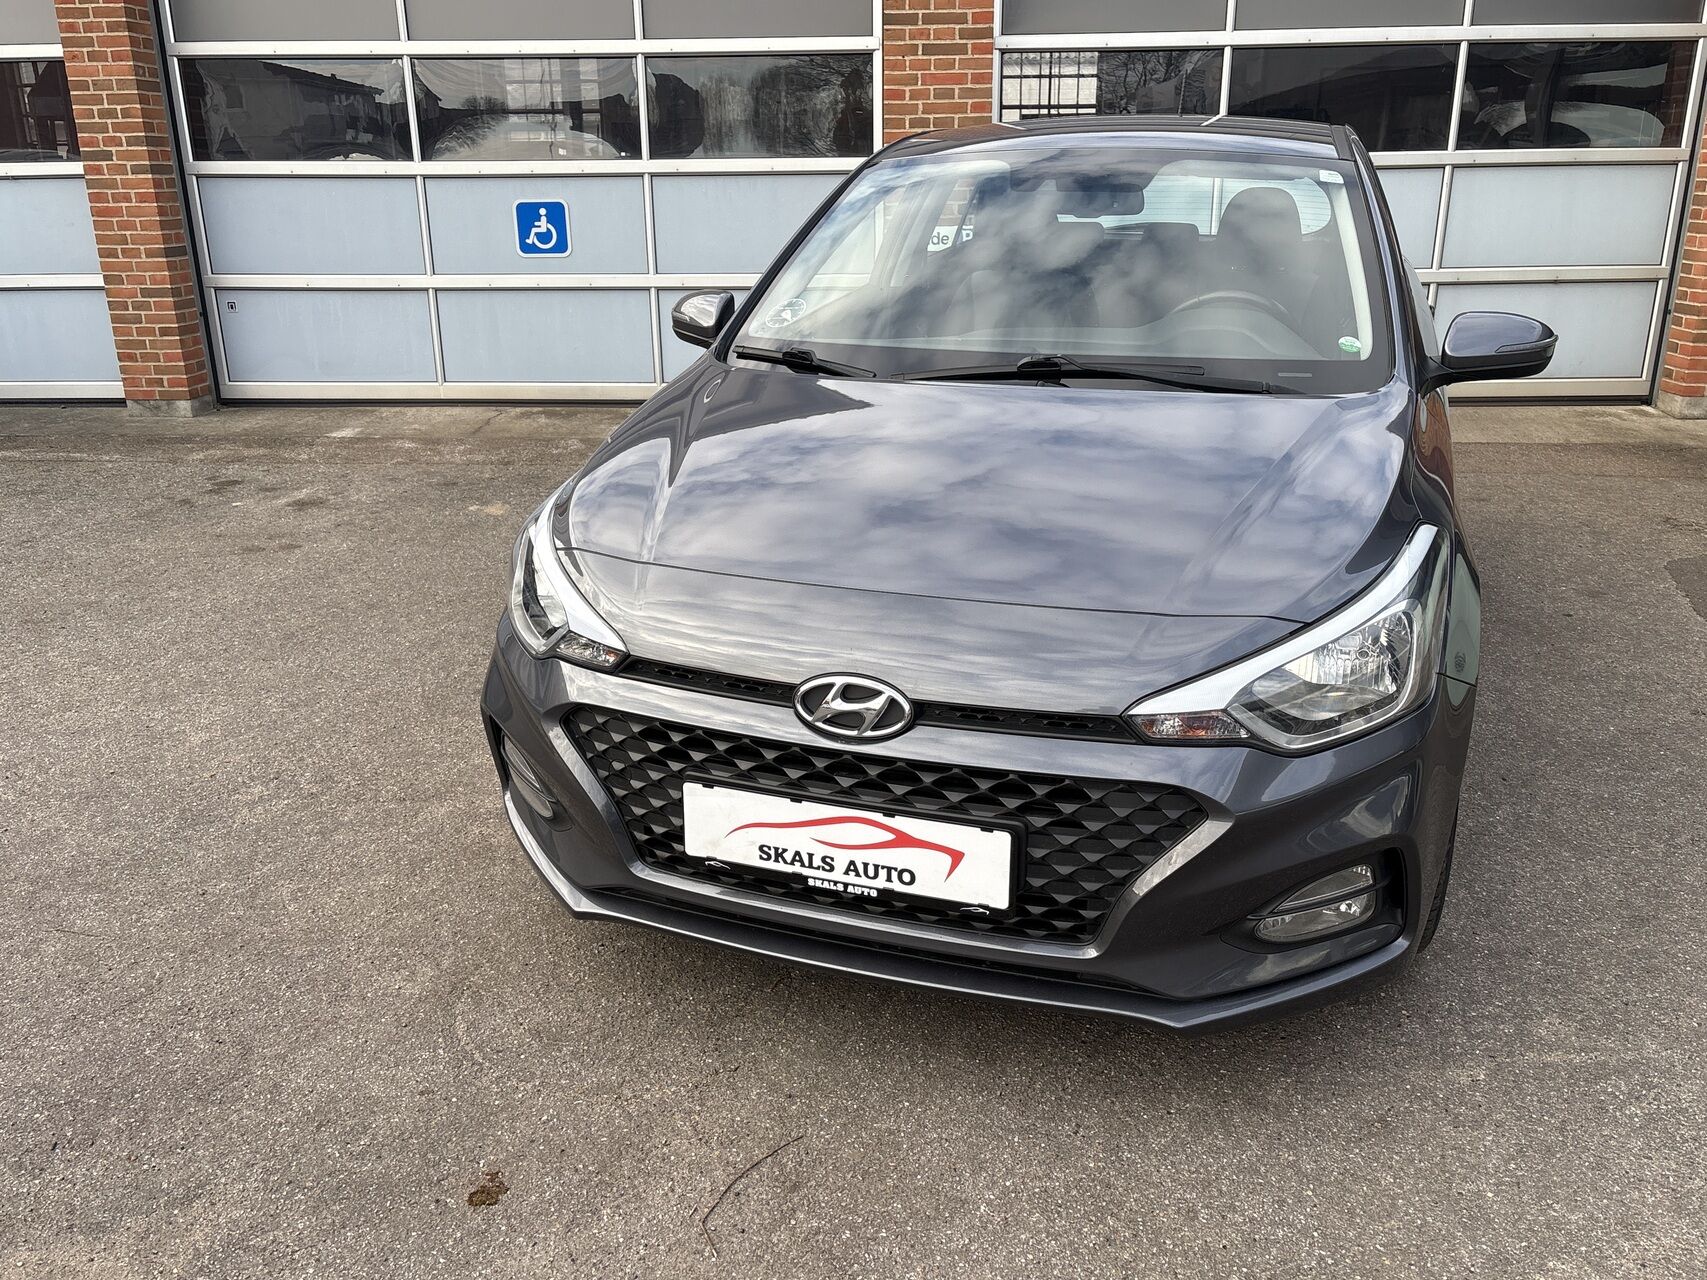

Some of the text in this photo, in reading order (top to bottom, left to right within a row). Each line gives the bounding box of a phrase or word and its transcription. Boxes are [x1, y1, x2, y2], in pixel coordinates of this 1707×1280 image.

[758, 844, 916, 886] SKALS AUTO
[807, 878, 878, 898] SKALS AUTO
